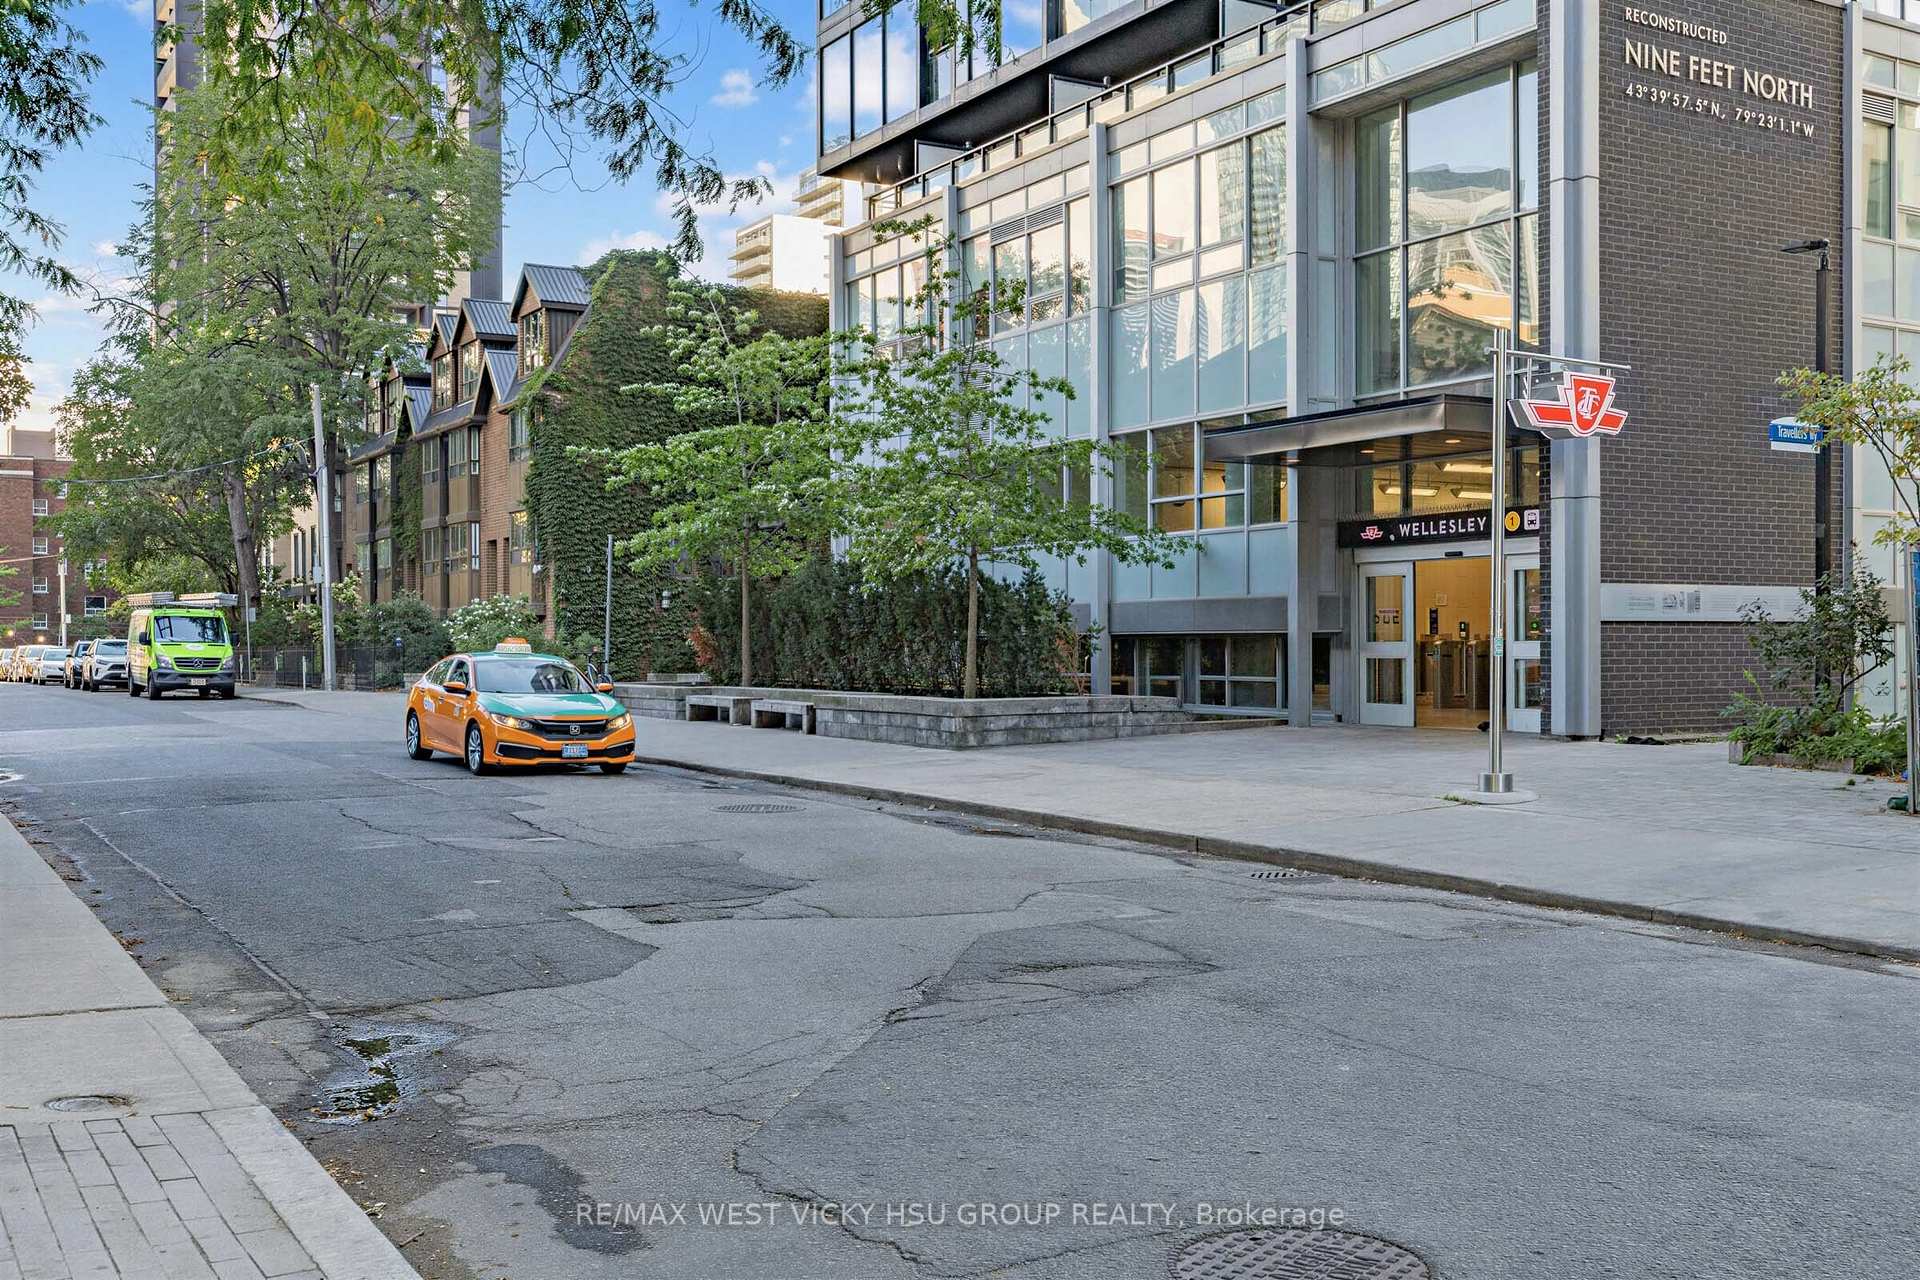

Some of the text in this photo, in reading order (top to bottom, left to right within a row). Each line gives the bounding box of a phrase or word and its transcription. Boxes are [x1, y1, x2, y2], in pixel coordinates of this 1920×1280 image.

[1625, 7, 1728, 45] RECONSTRUCTED
[1625, 37, 1814, 110] NINE FEET NORTH
[1399, 516, 1487, 537] WELLESLEY
